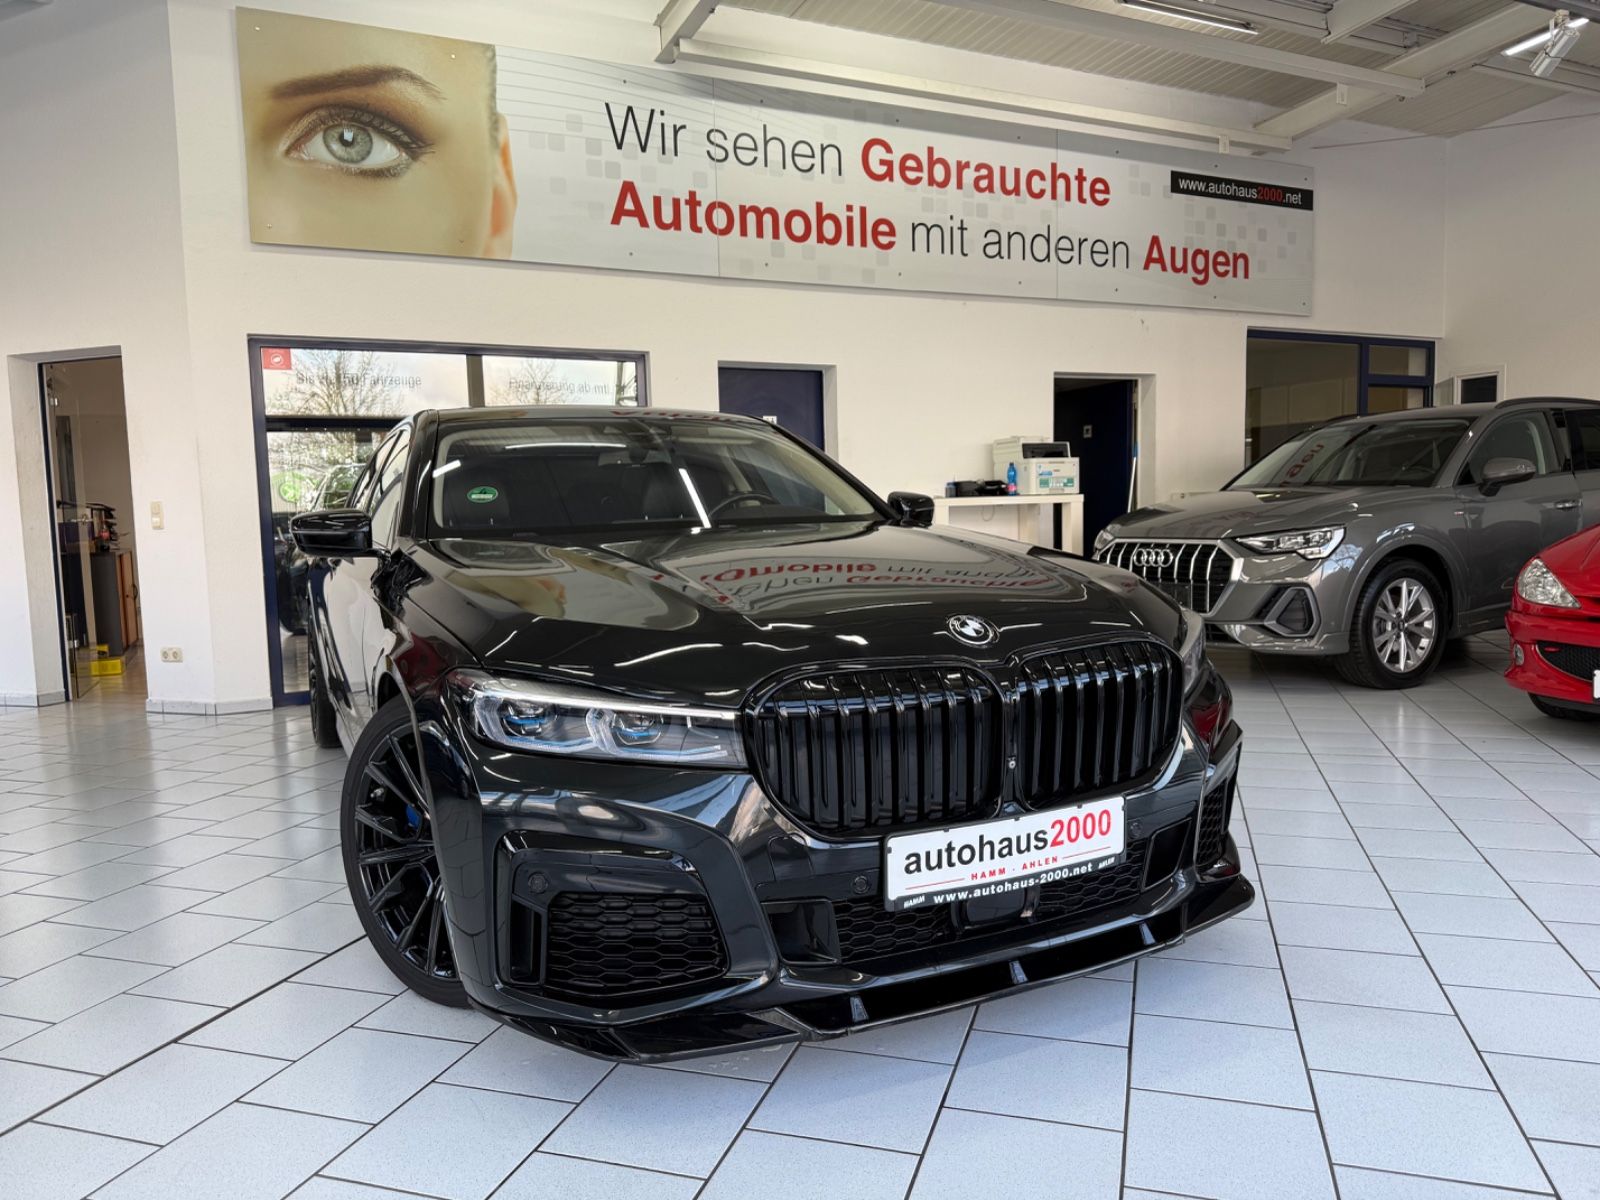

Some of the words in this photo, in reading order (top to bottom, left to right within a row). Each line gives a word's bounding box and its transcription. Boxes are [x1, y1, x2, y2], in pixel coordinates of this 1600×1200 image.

[604, 102, 687, 157] Wir
[706, 123, 843, 177] sehen
[861, 137, 1111, 207] Gebrauchte
[1178, 178, 1302, 205] www.autohaus2000.net
[610, 180, 897, 251] Automobile
[911, 214, 969, 257] mit
[982, 225, 1130, 269] anderen
[1143, 235, 1250, 286] Augen
[363, 373, 422, 389] Fahrzeuge
[578, 379, 591, 393] ab
[904, 808, 1112, 875] autohaus2000
[933, 861, 1093, 904] www.autohaus-2000.net
[971, 867, 1006, 881] HAMM
[1022, 856, 1059, 870] AHLEN
